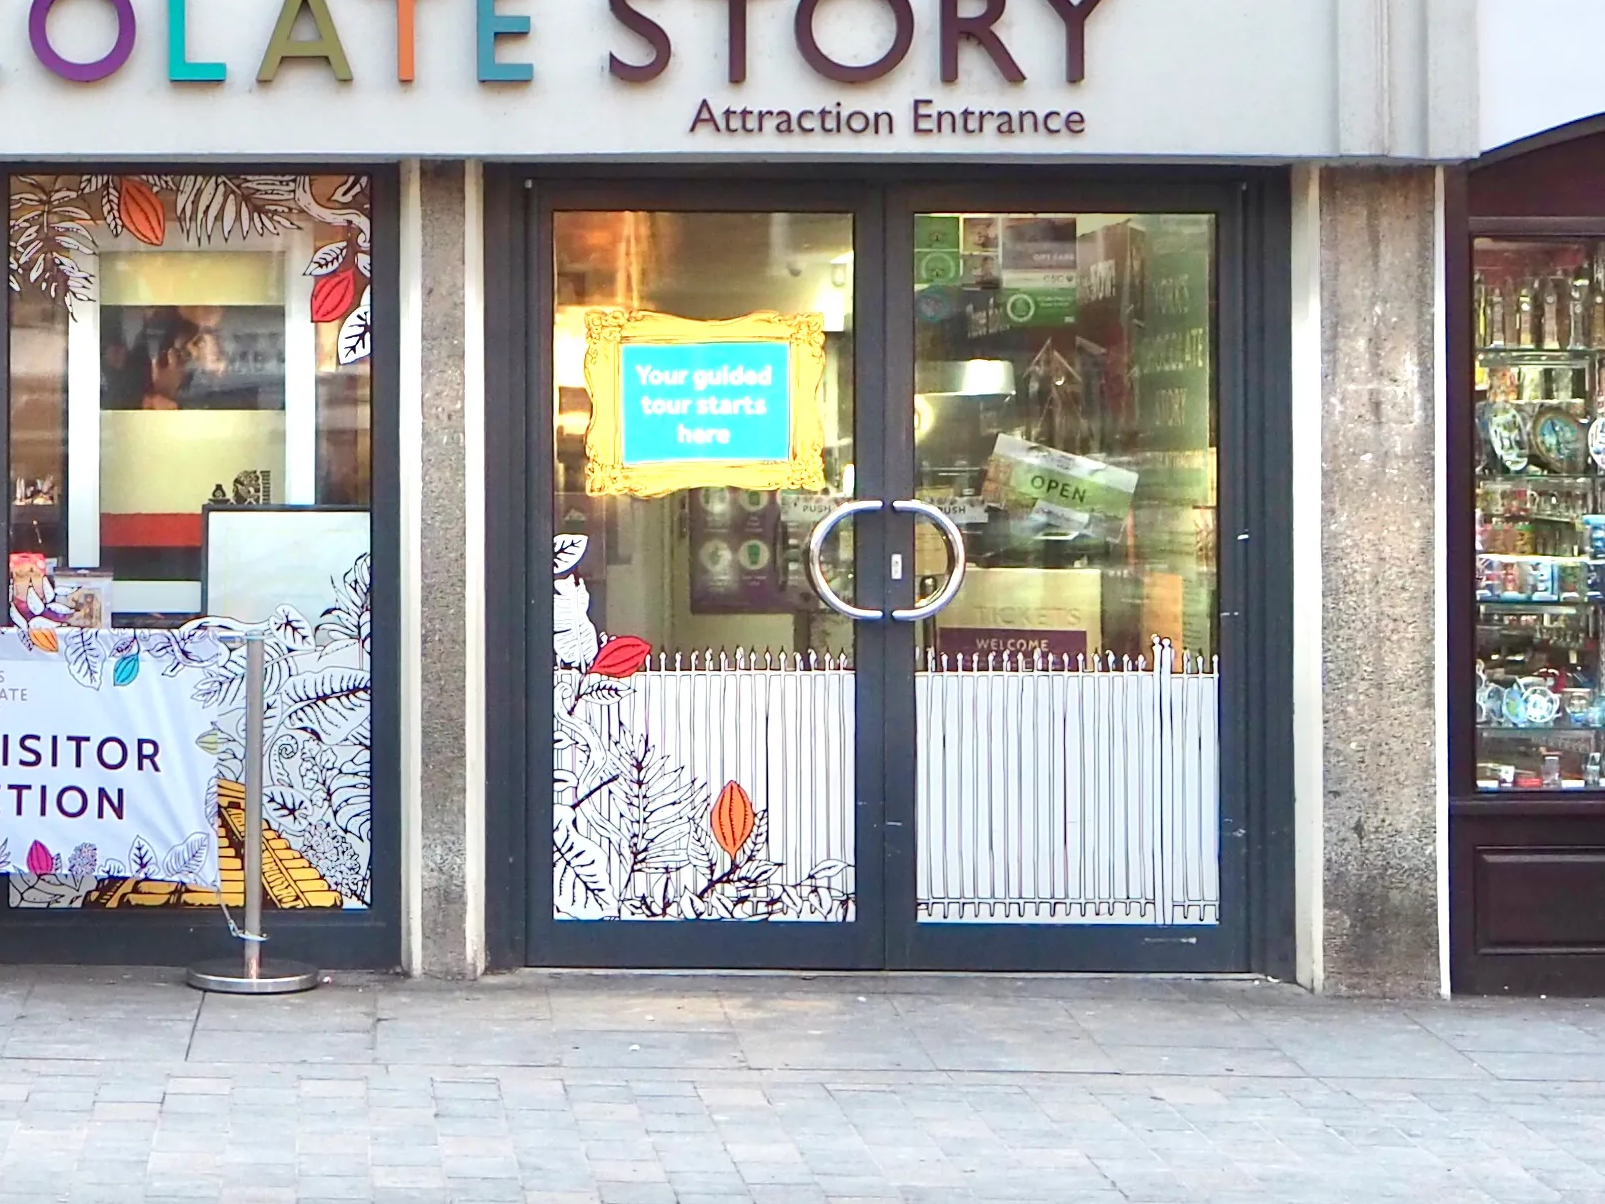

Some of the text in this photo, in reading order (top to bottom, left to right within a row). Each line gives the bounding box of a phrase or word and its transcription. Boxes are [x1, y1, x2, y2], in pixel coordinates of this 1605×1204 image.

[688, 98, 1087, 136] Attraction Entrance
[635, 364, 773, 391] Your guided
[640, 396, 768, 415] tour starts
[677, 423, 732, 444] here
[1026, 475, 1087, 504] OPEN
[972, 605, 1082, 626] TICKETS
[975, 637, 1050, 652] WELCOME
